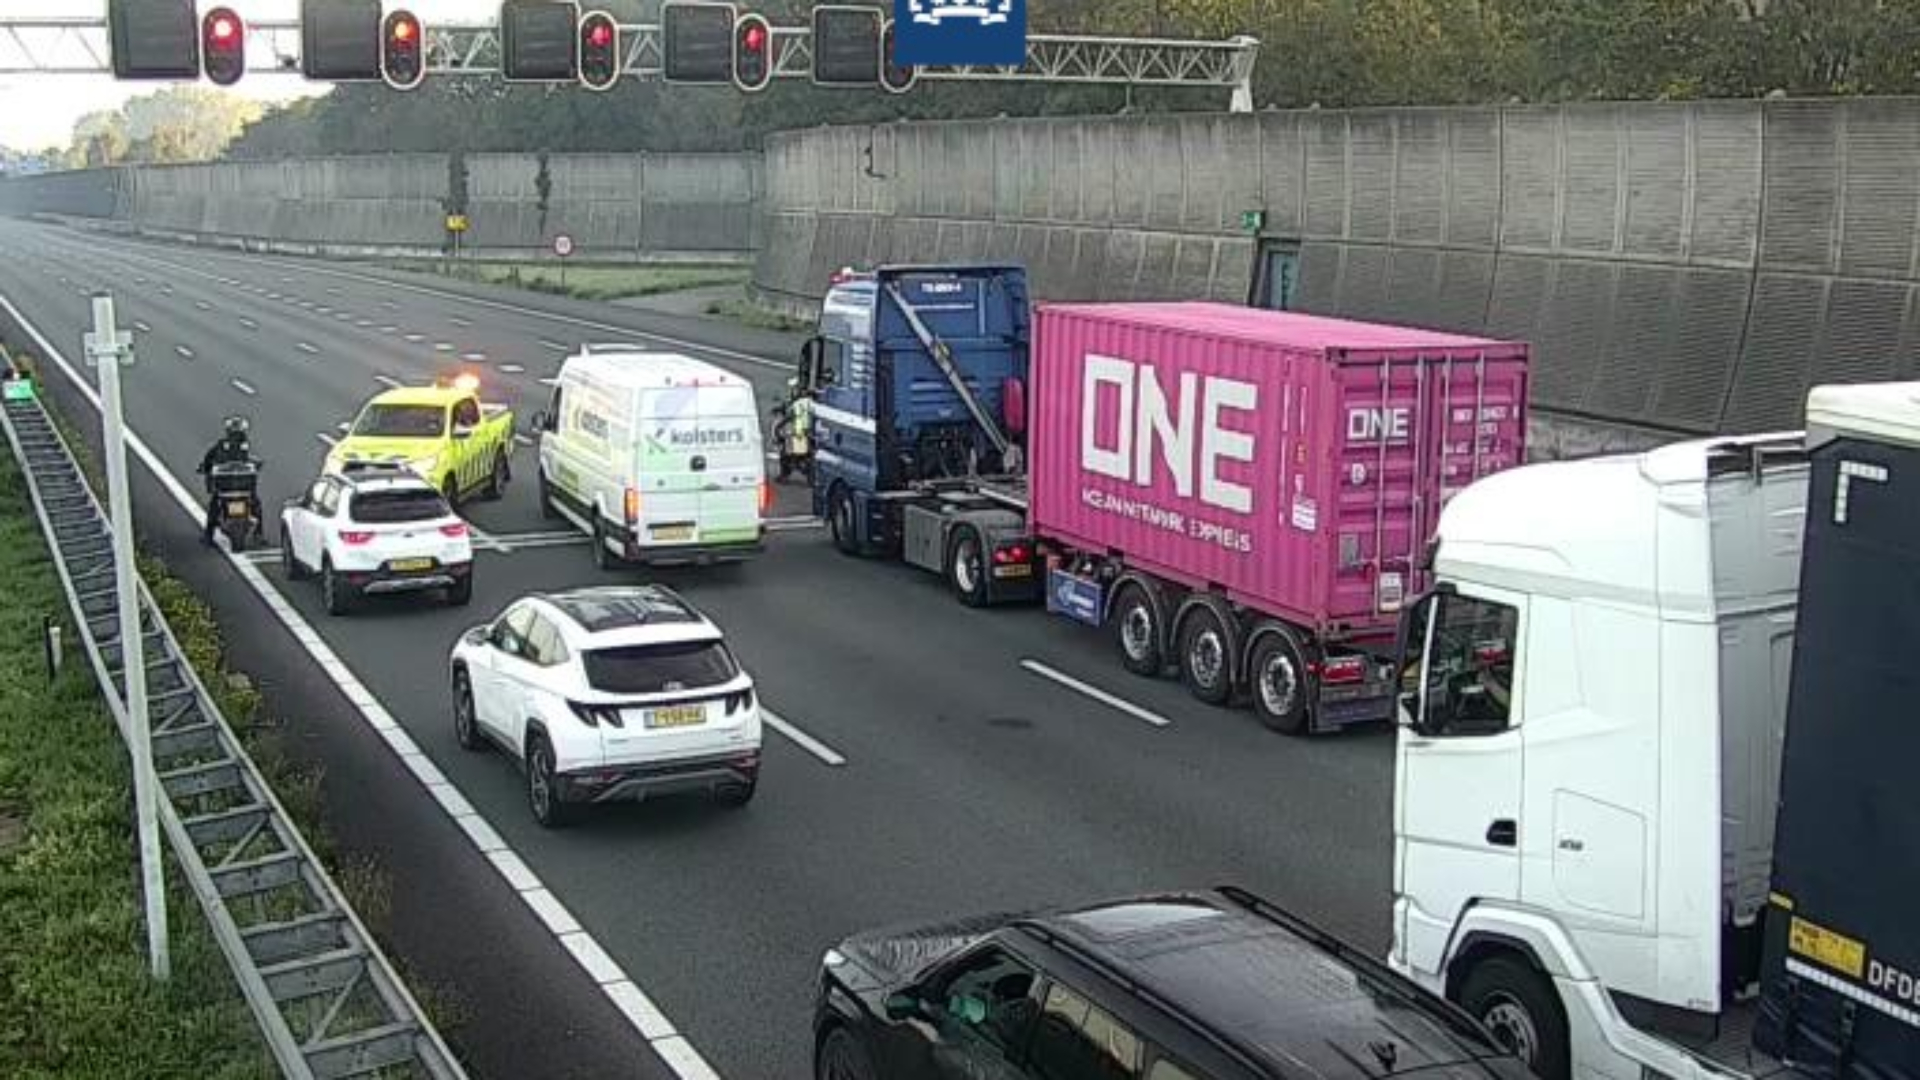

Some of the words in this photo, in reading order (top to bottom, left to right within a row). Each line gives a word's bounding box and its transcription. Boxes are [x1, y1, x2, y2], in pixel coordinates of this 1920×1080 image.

[670, 427, 744, 445] kolsters
[1083, 354, 1257, 513] ONE
[1347, 408, 1409, 440] ONE
